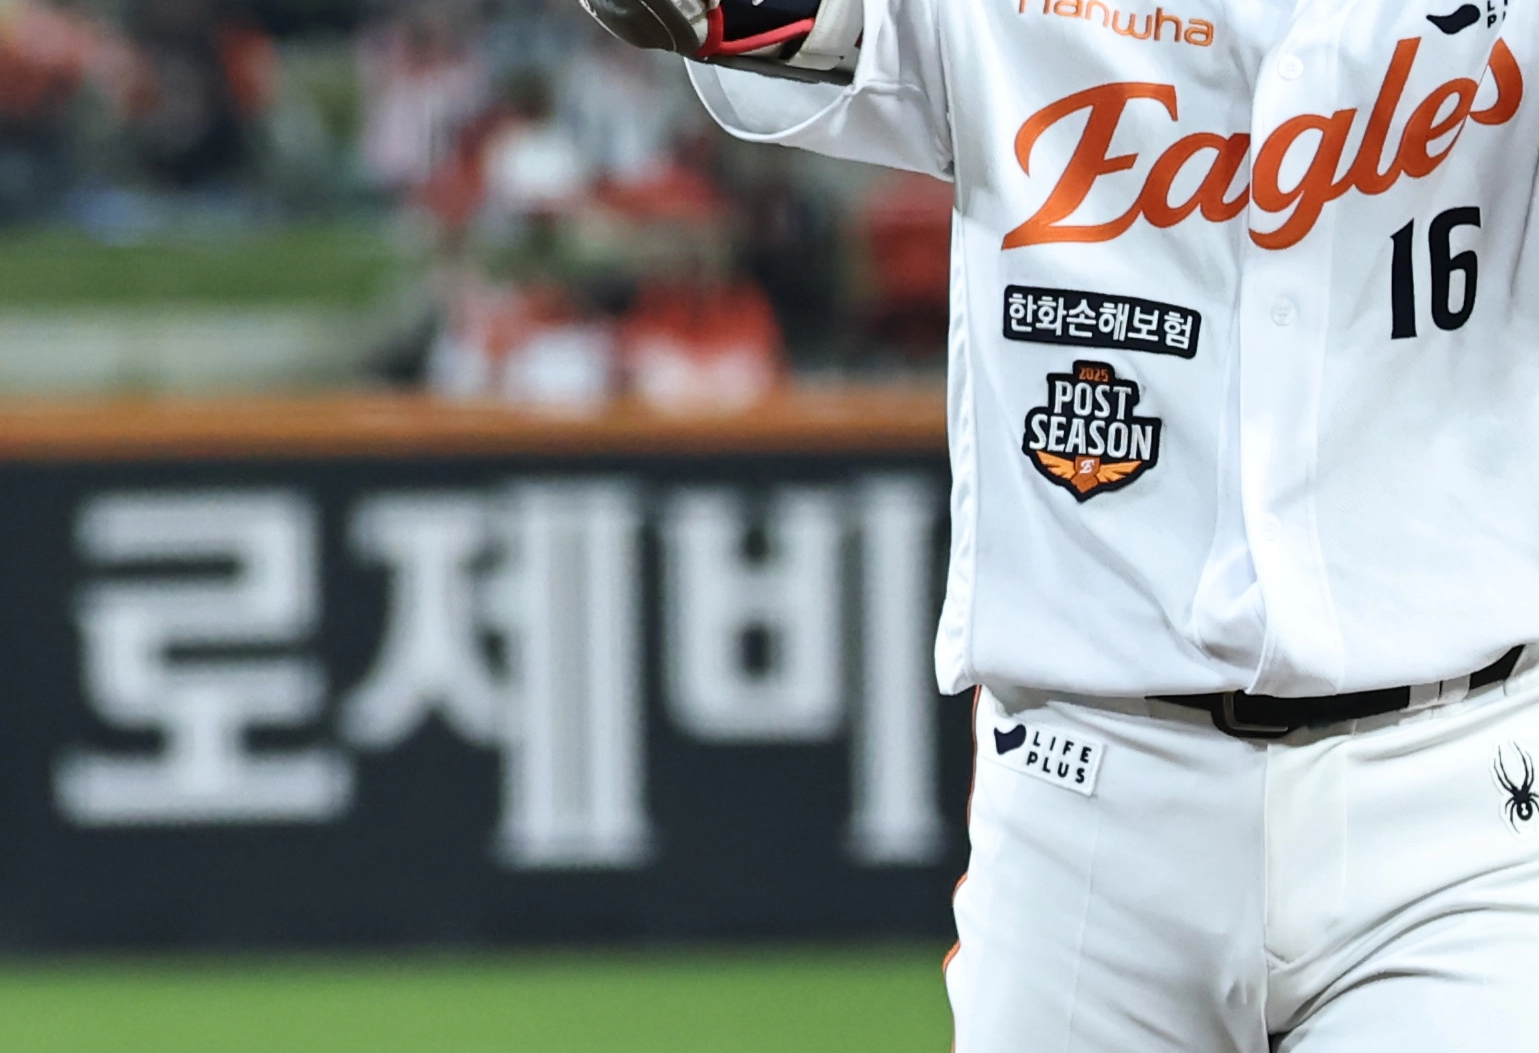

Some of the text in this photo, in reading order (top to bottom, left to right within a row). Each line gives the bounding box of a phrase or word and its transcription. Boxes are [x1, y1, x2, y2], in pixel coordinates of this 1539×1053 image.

[1001, 36, 1524, 251] Eagles
[1390, 206, 1481, 340] 16
[1008, 293, 1193, 350] 한화손해보험
[1079, 367, 1109, 382] 2025
[1053, 380, 1132, 420] POST
[1029, 413, 1153, 461] SEASON
[51, 473, 946, 869] 로제비
[1026, 751, 1086, 784] PLUS
[1032, 731, 1093, 764] LIFE
